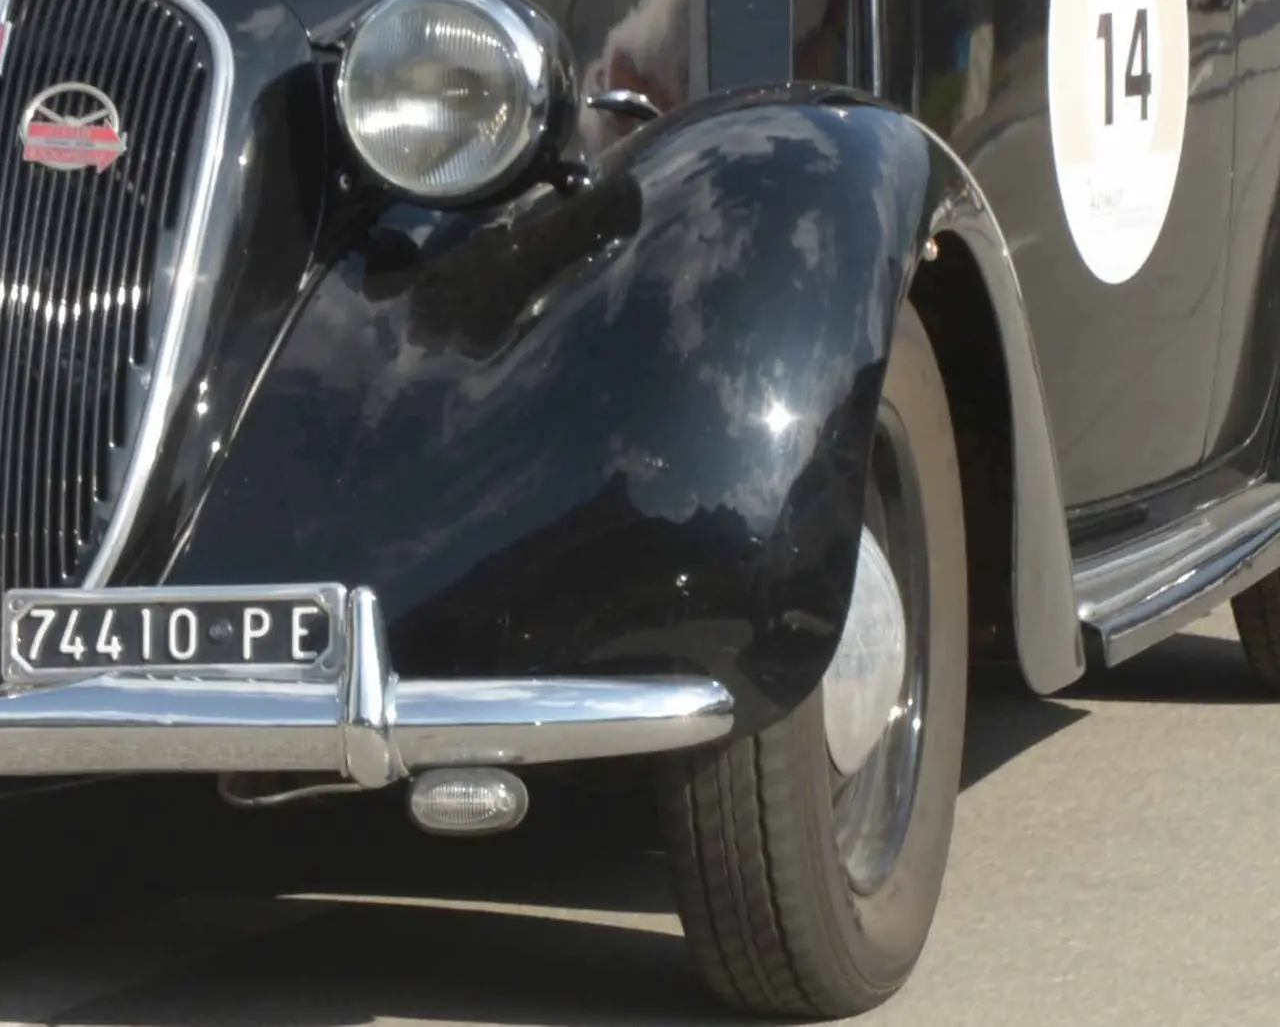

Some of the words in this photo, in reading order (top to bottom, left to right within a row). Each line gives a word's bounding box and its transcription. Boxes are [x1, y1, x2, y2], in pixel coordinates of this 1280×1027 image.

[1096, 7, 1153, 127] 14
[29, 607, 199, 662] 74410
[242, 606, 319, 661] PE
